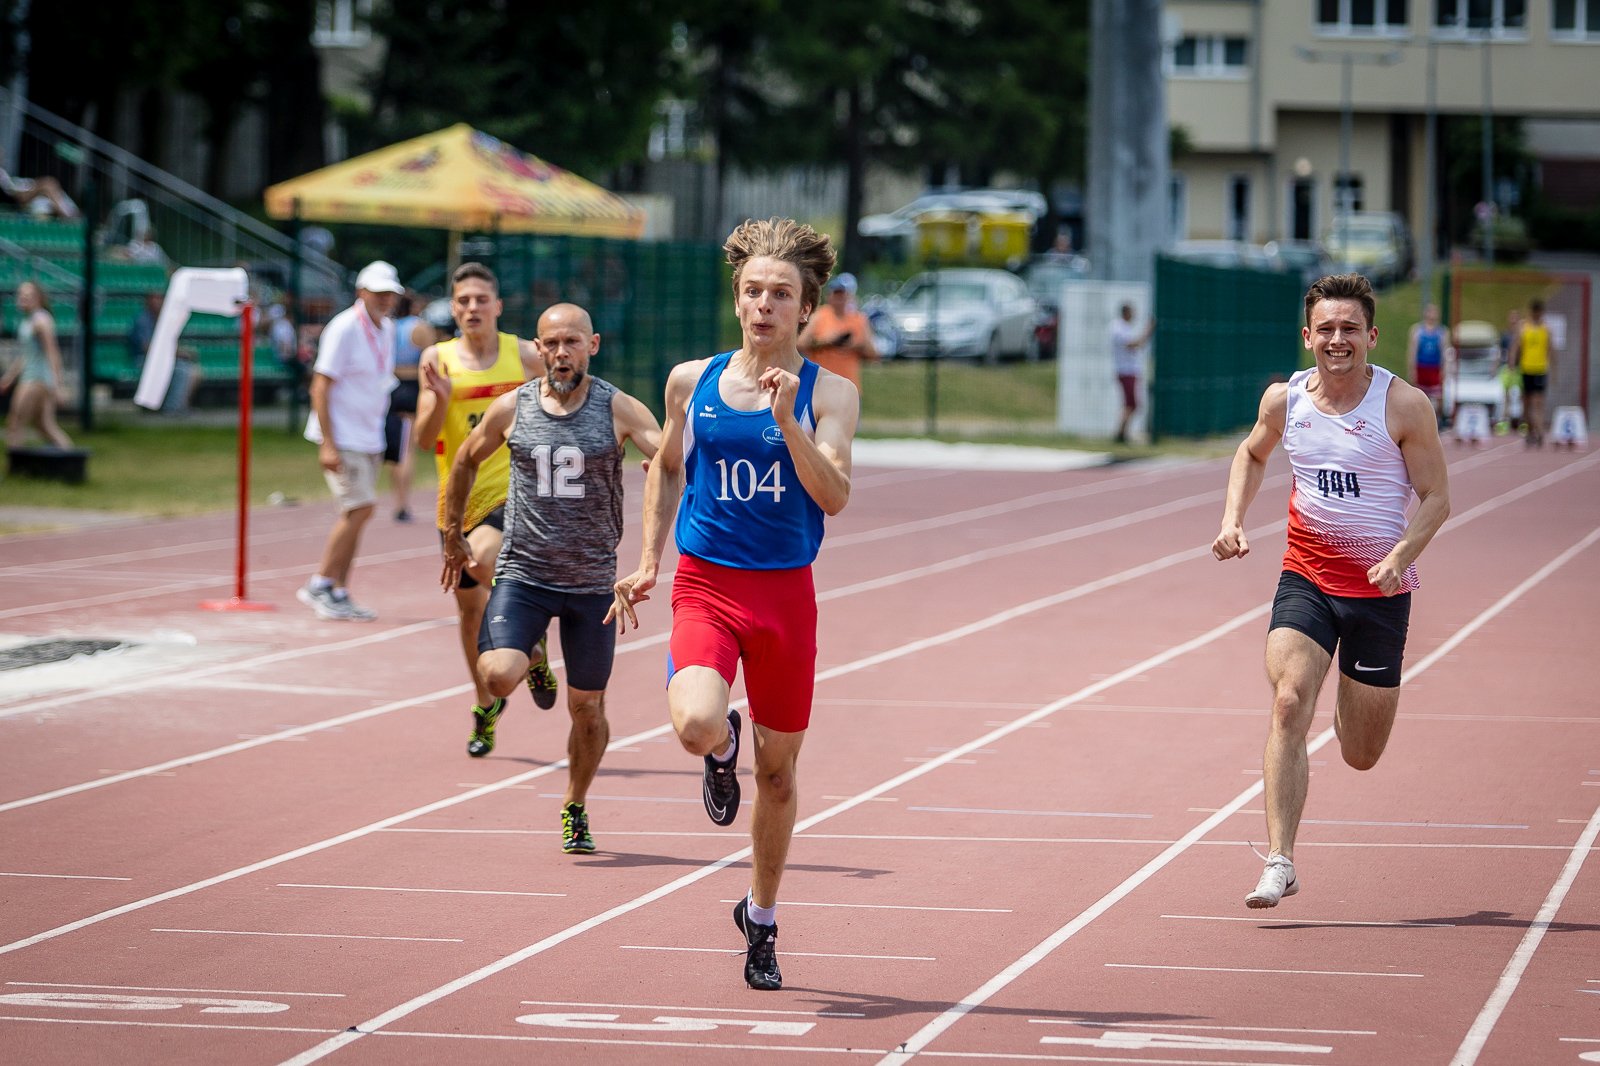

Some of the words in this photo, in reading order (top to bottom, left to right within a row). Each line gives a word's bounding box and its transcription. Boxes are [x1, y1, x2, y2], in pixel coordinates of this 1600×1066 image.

[1294, 420, 1312, 429] esa
[531, 444, 586, 499] 12
[715, 458, 786, 503] 104
[1317, 469, 1361, 498] 444
[515, 1012, 817, 1037] 5
[1039, 1030, 1333, 1054] 4
